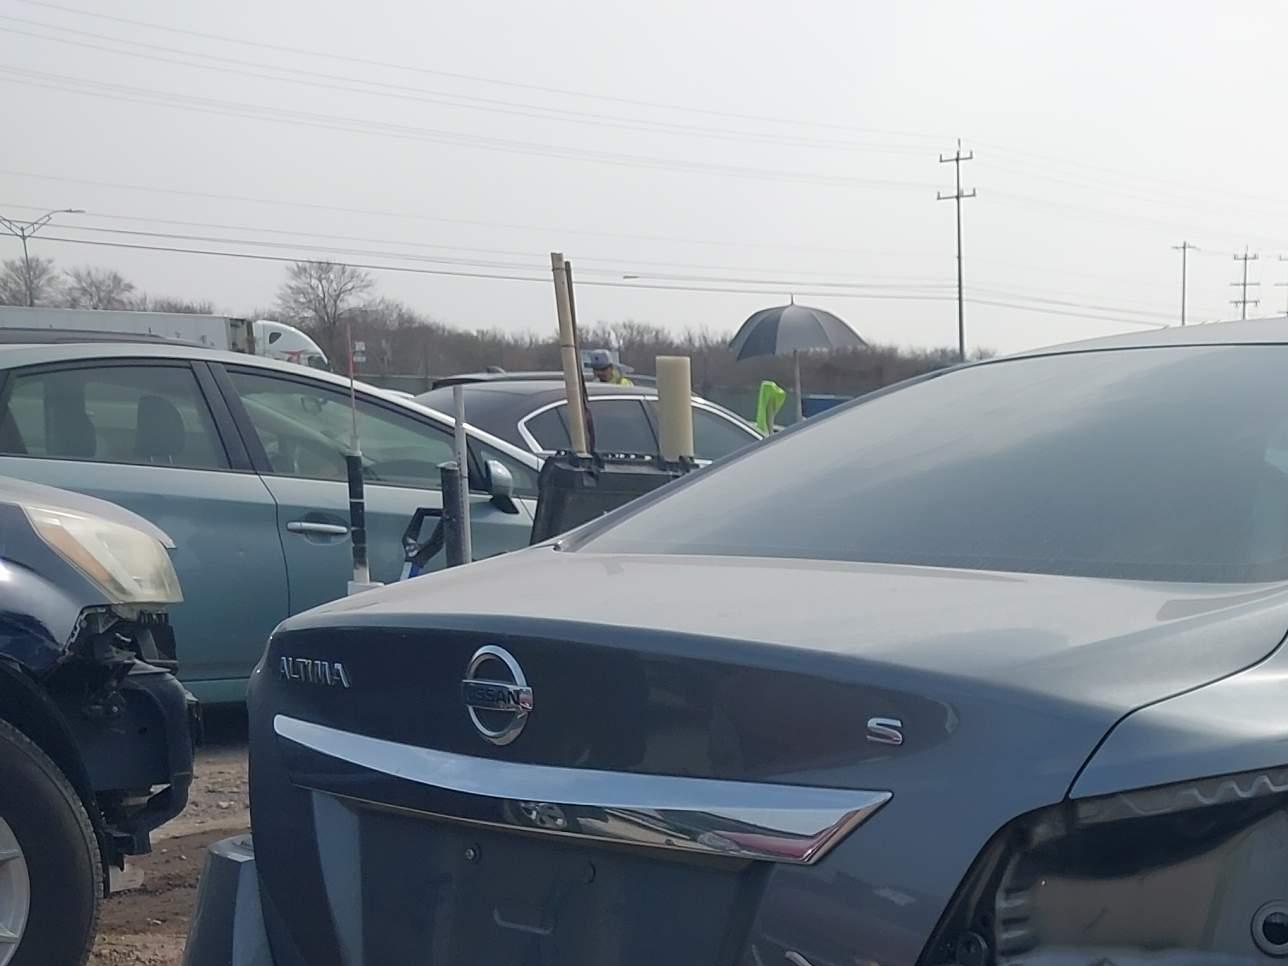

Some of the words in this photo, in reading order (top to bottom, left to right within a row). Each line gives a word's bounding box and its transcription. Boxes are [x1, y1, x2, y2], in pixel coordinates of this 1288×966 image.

[280, 656, 350, 688] ALTIMA
[465, 685, 520, 706] SSAN
[866, 717, 903, 745] S
